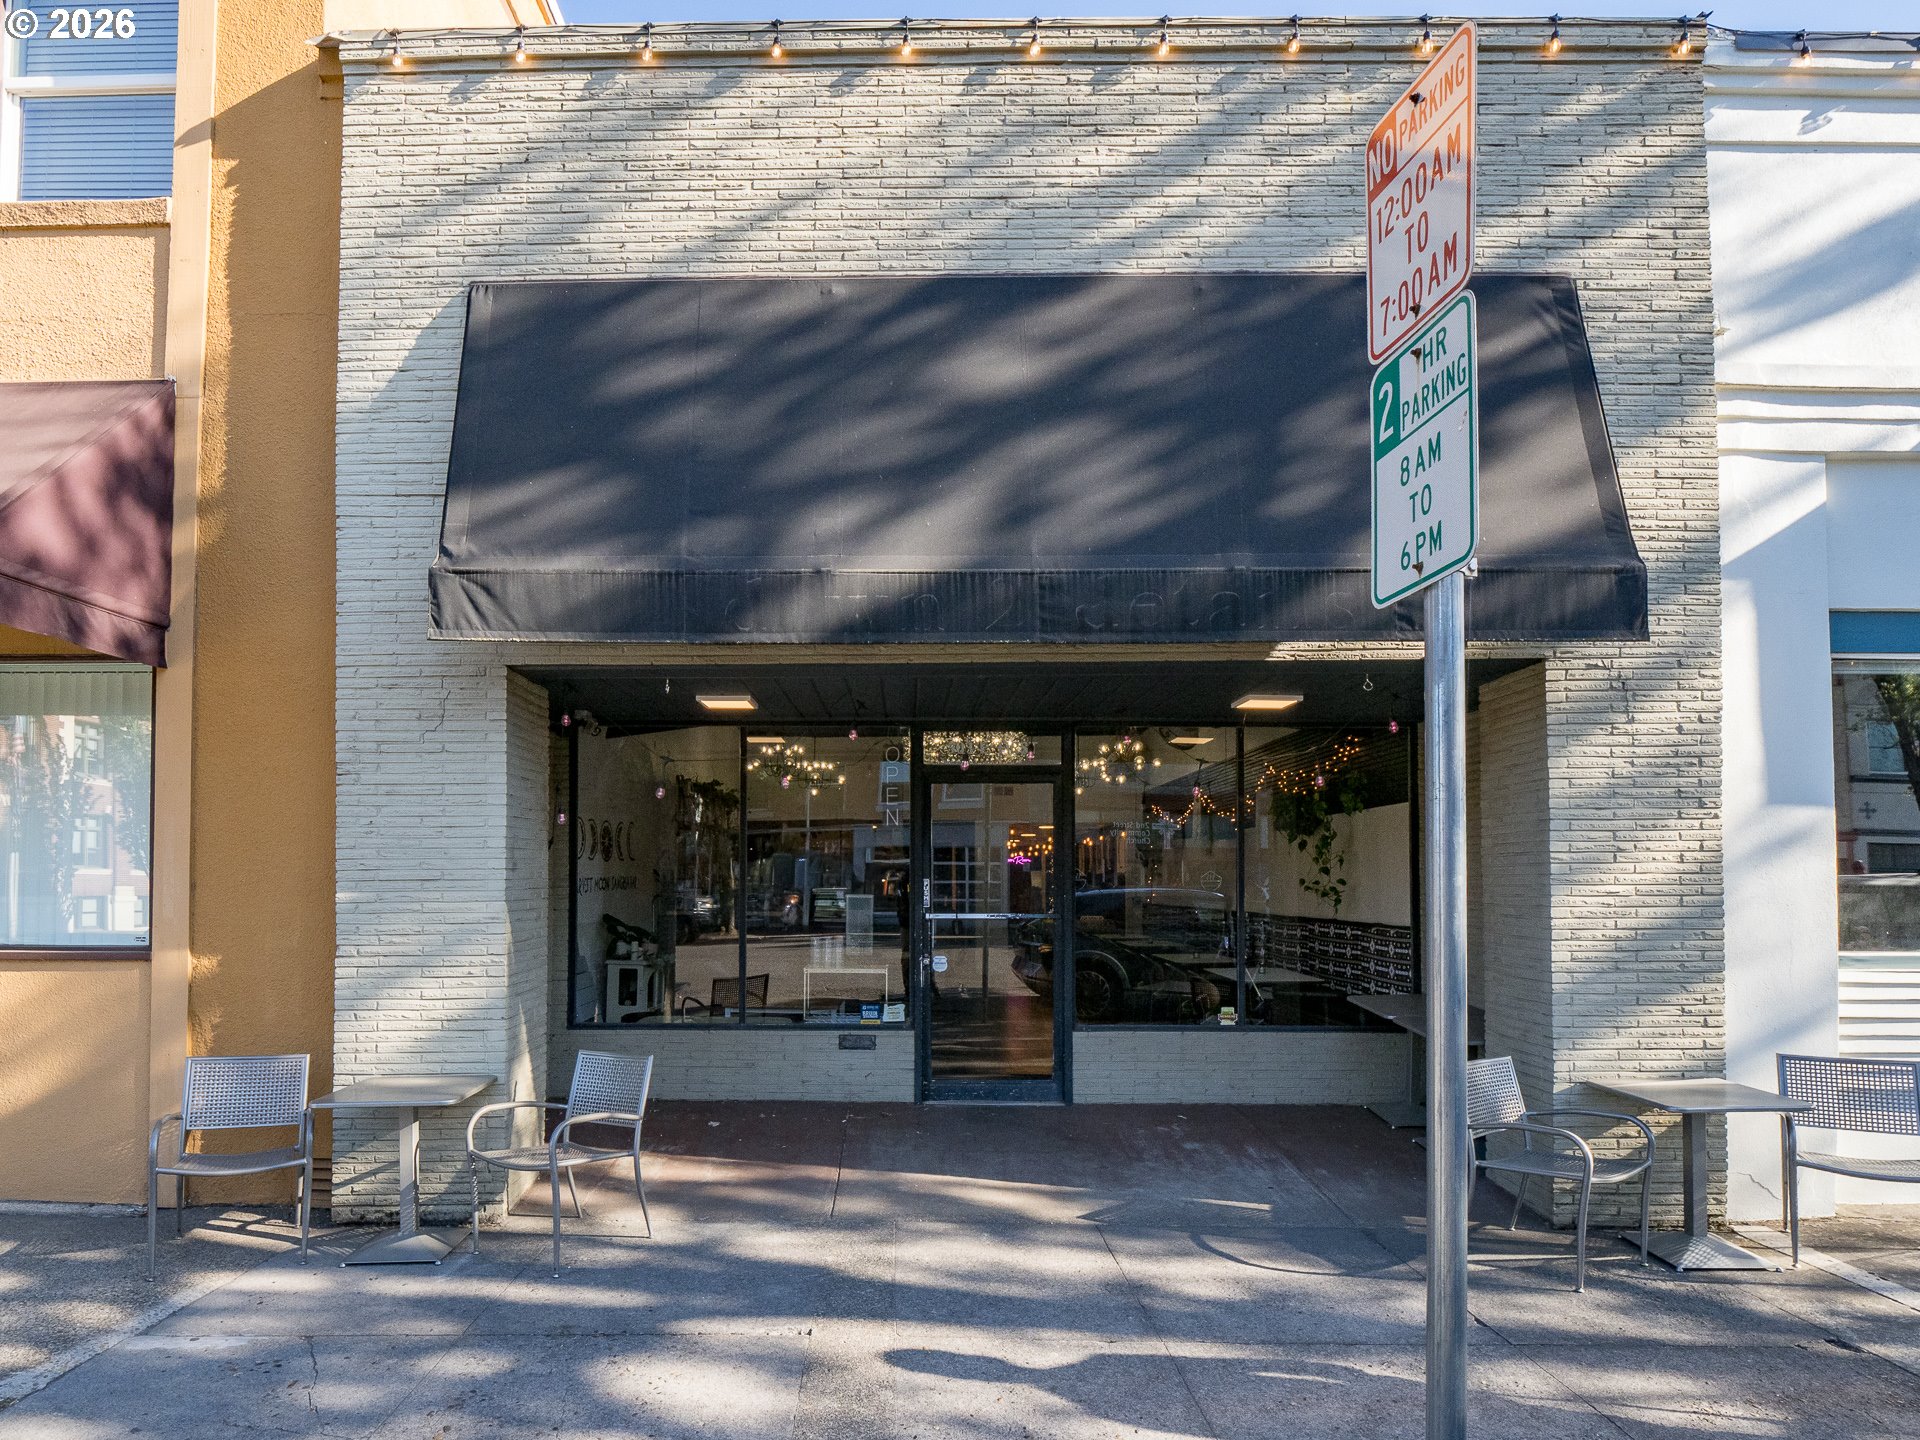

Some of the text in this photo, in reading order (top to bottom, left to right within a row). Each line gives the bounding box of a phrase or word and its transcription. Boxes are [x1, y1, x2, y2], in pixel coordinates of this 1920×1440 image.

[1369, 52, 1465, 192] NO PARKING
[1404, 211, 1429, 264] TO
[1378, 327, 1447, 444] 2 HR
[1401, 353, 1466, 431] PARKING
[1409, 484, 1432, 523] TO
[885, 746, 900, 826] OPEN
